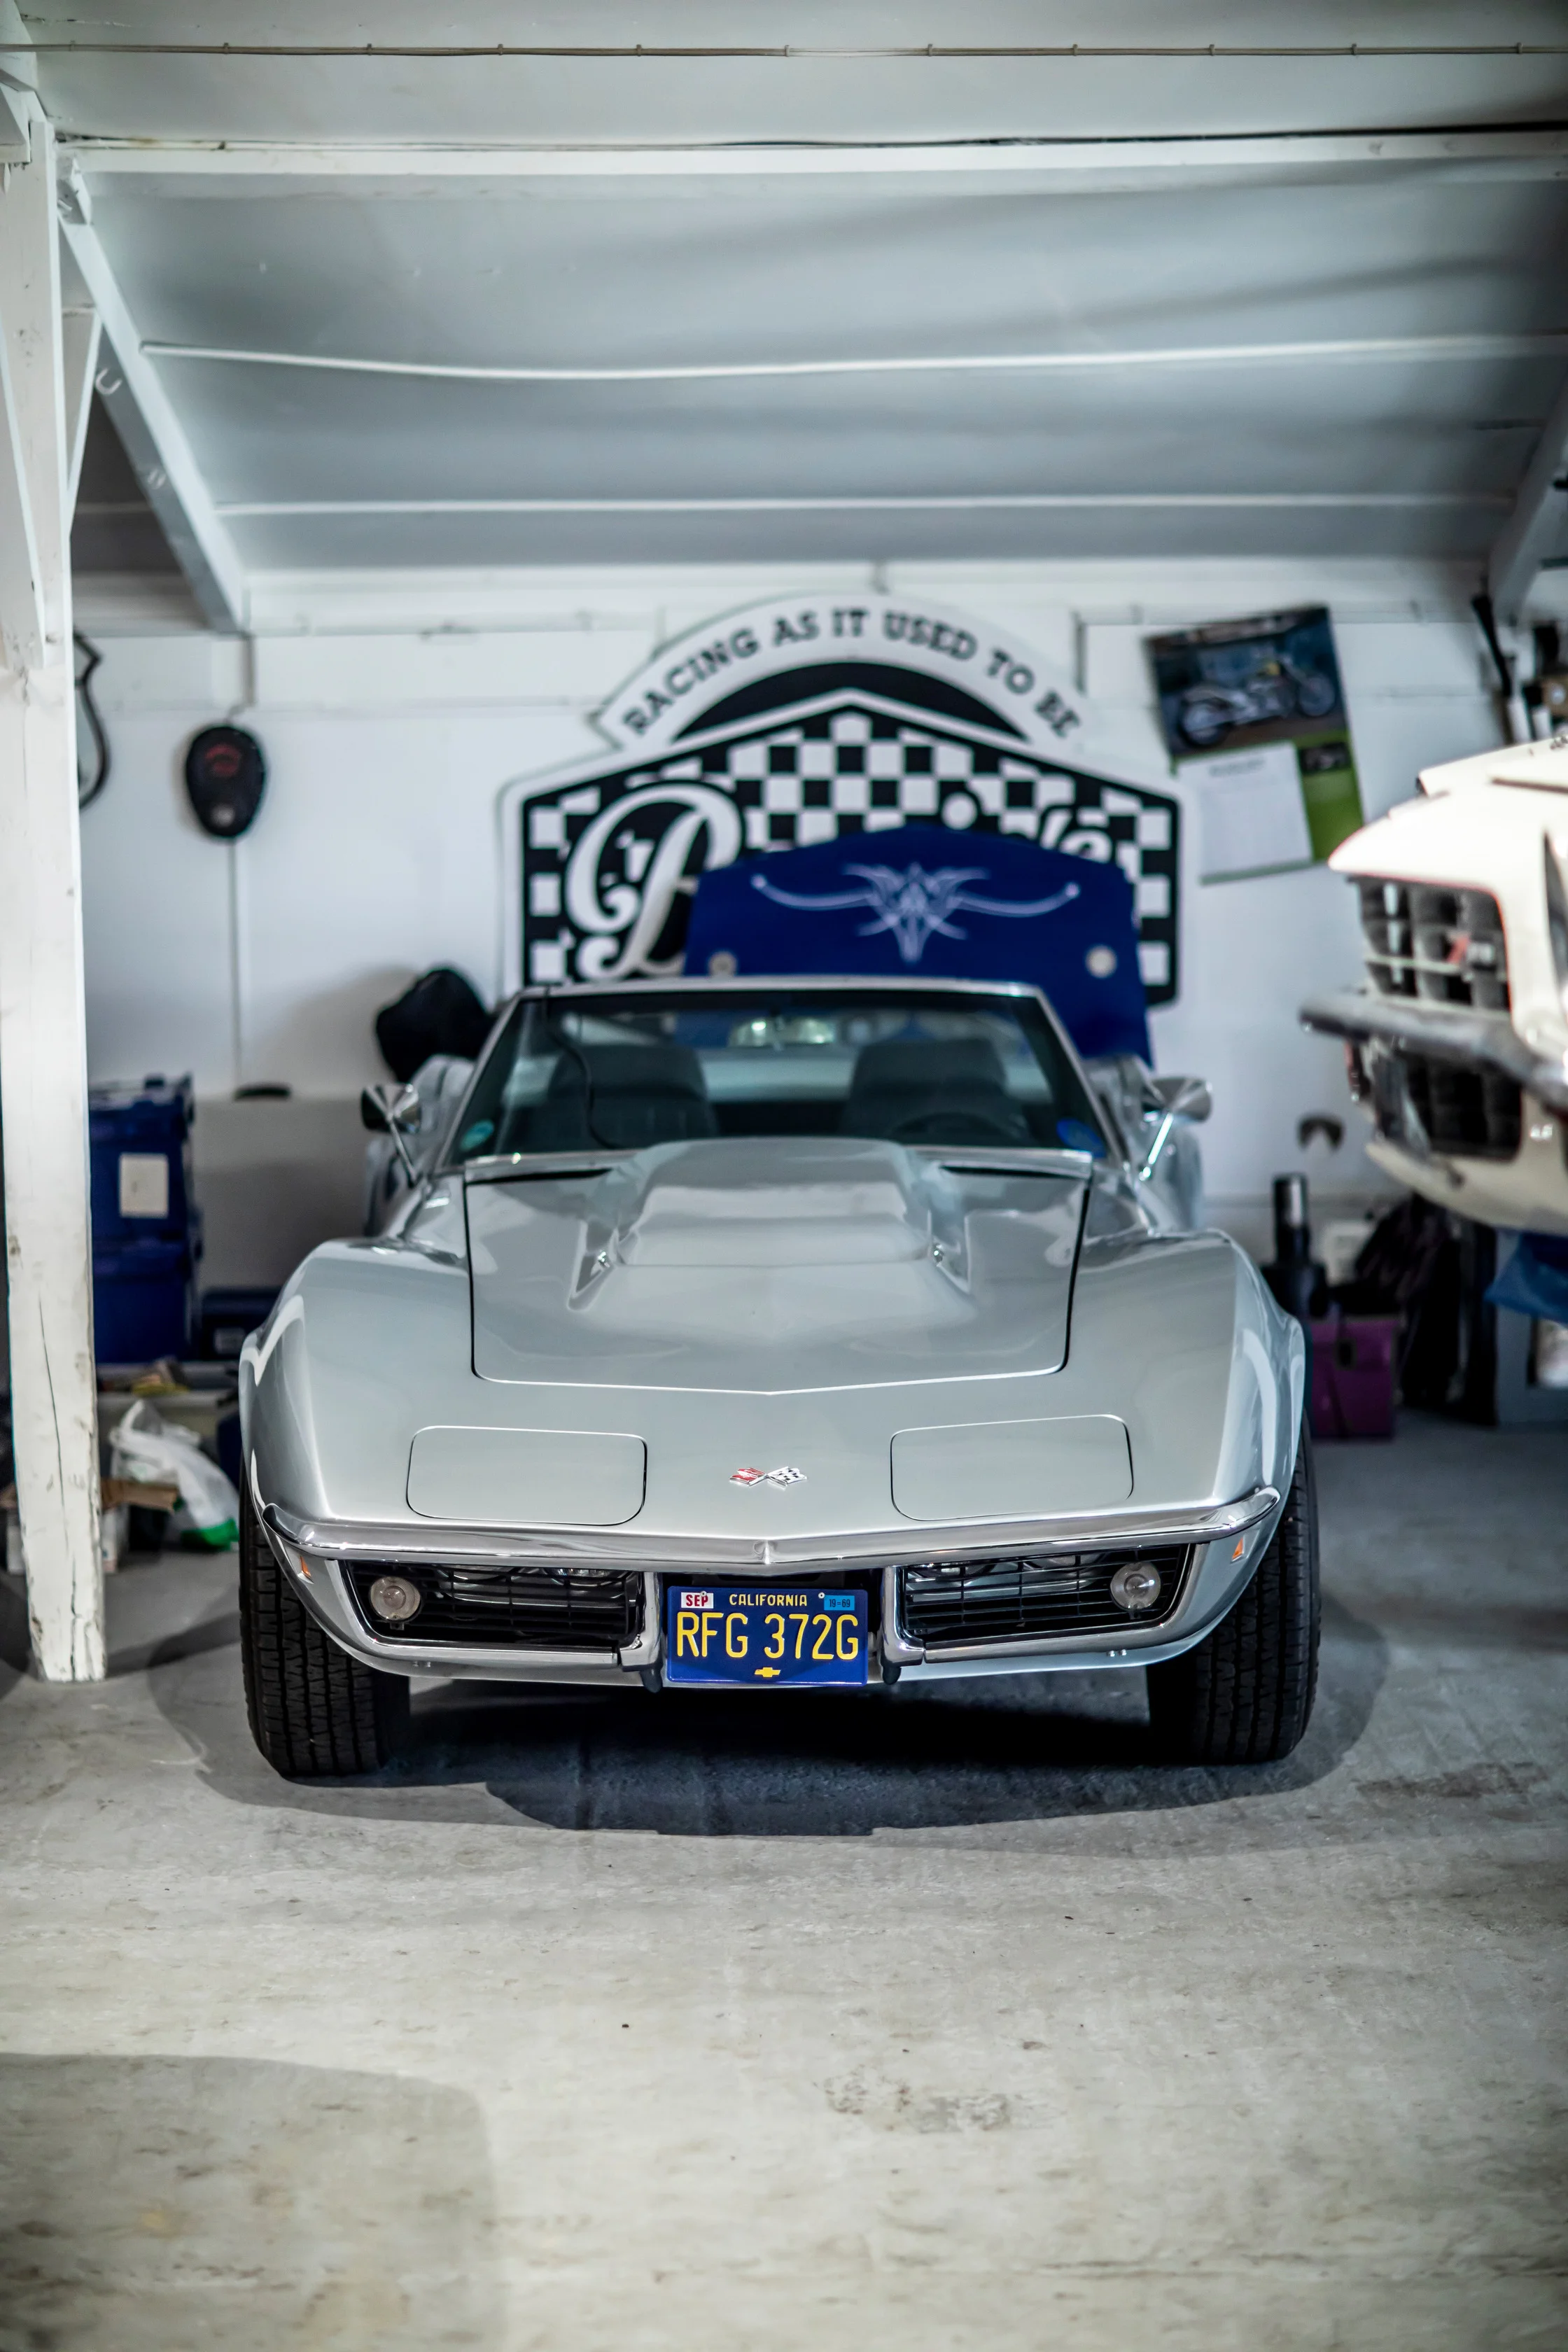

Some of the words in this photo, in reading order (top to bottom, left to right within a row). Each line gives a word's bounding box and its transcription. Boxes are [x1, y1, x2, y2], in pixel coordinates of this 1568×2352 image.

[622, 626, 760, 736] RACING
[774, 610, 820, 645] AS
[832, 608, 869, 637] IT
[883, 610, 978, 662] USED
[987, 647, 1035, 695] TO
[1033, 690, 1081, 737] BE
[685, 1594, 709, 1607] SEP
[729, 1593, 808, 1606] CALIFORNIA
[677, 1611, 748, 1658] RFG
[764, 1613, 858, 1660] 372G
